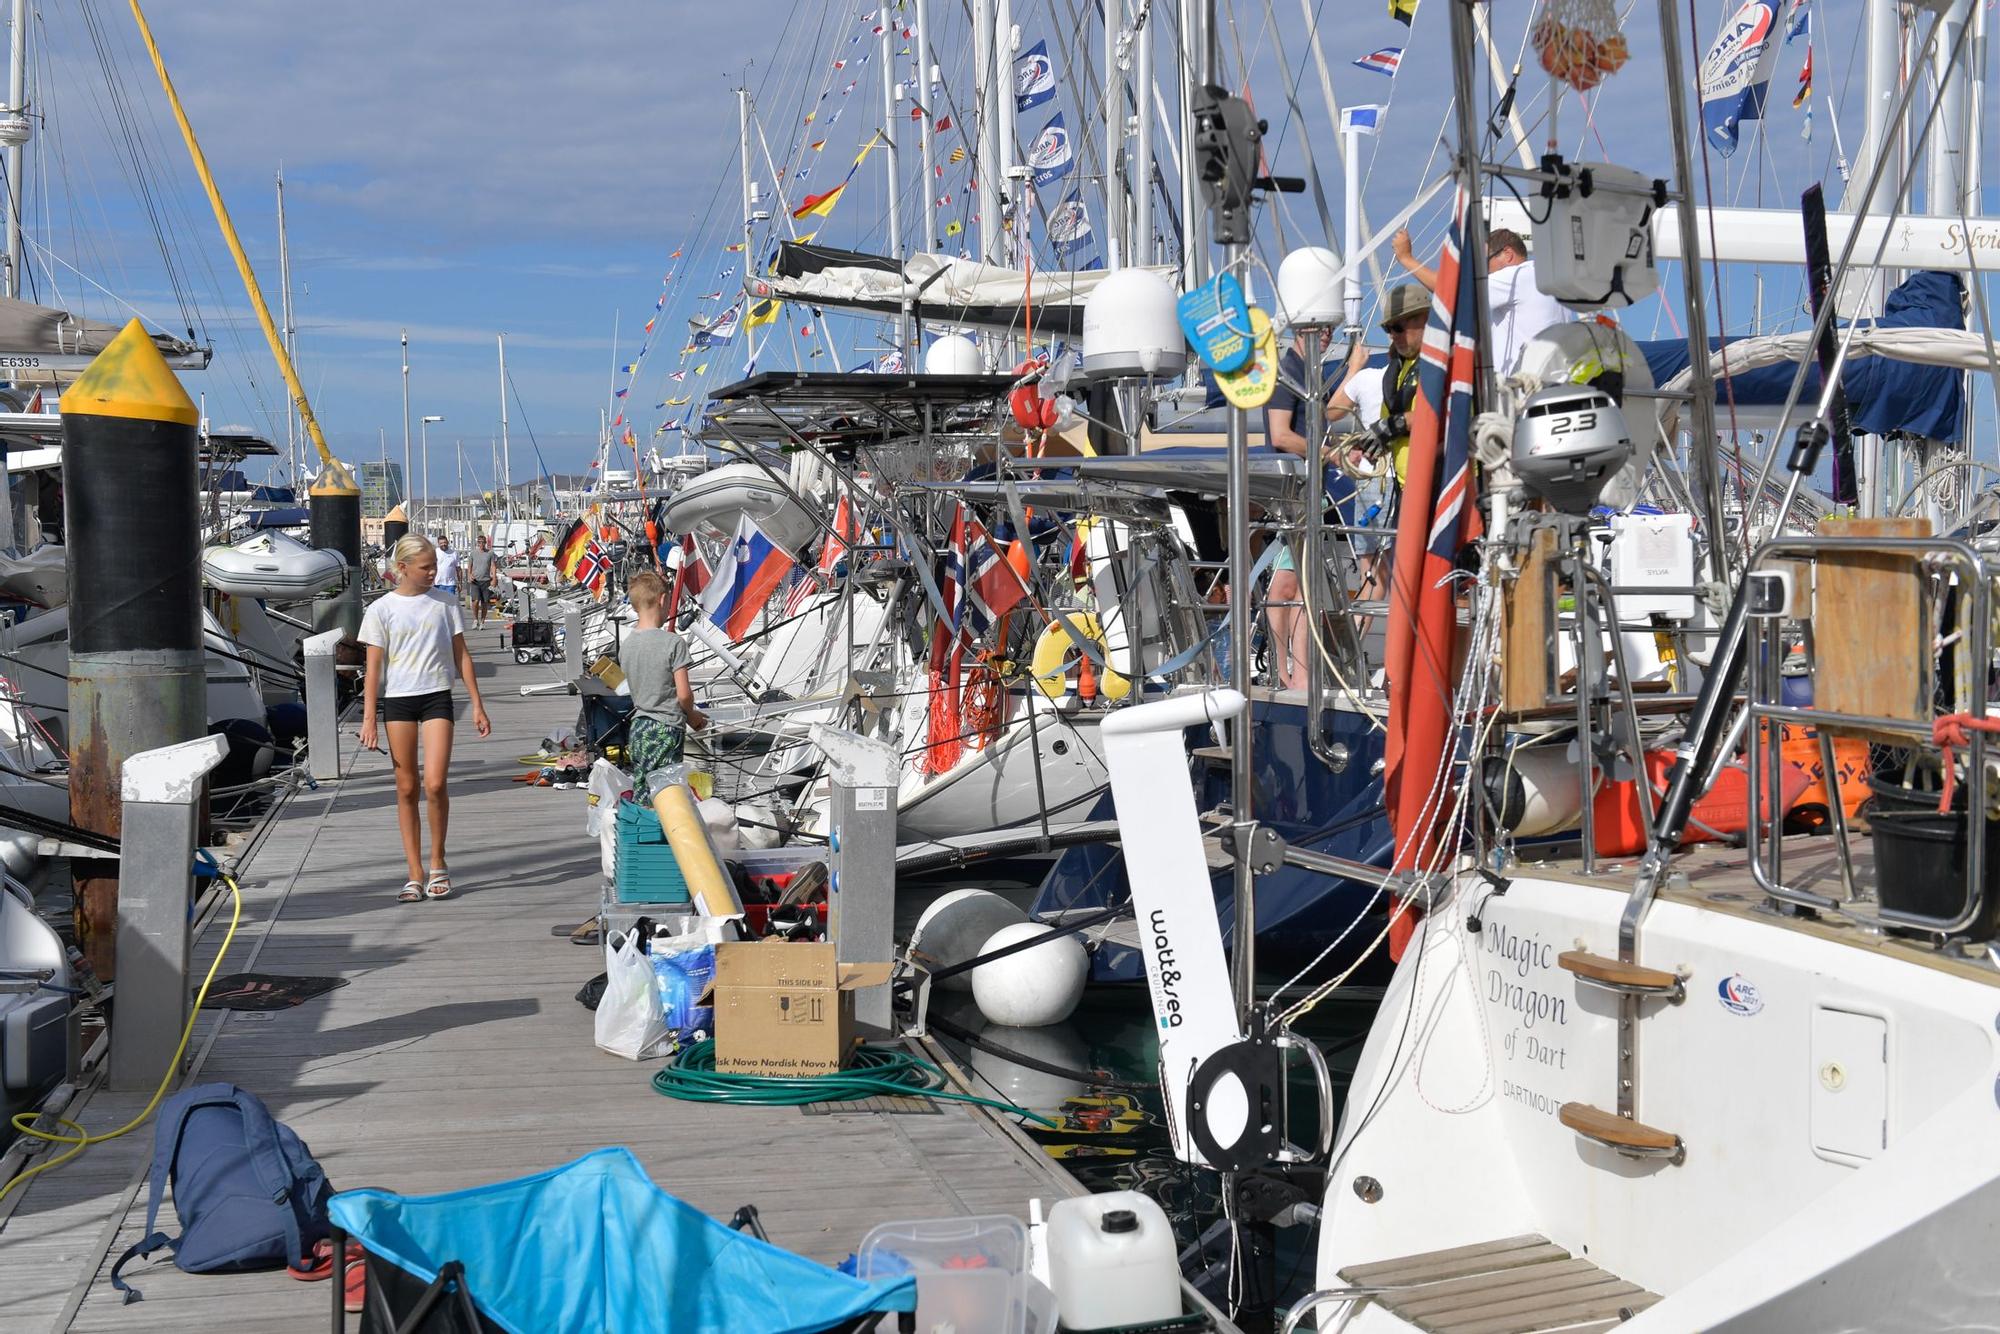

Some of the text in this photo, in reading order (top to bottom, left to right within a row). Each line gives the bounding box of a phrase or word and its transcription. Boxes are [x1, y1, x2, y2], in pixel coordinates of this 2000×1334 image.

[1940, 223, 2000, 256] Sylvi
[0, 357, 40, 368] E6393
[1550, 413, 1598, 436] 2.3
[1487, 921, 1552, 978] Magic
[778, 978, 823, 987] THIS SIDE UP
[1150, 909, 1183, 1028] watt&sea
[1150, 965, 1166, 1015] CRUISING
[1487, 969, 1568, 1029] Dragon
[1734, 983, 1756, 996] ARC
[716, 1057, 730, 1066] isk
[732, 1058, 758, 1067] Novo
[760, 1058, 798, 1068] Nordisk
[800, 1059, 826, 1069] Novo
[1504, 1027, 1567, 1070] of Dart
[1503, 1079, 1562, 1118] DARTMOUT
